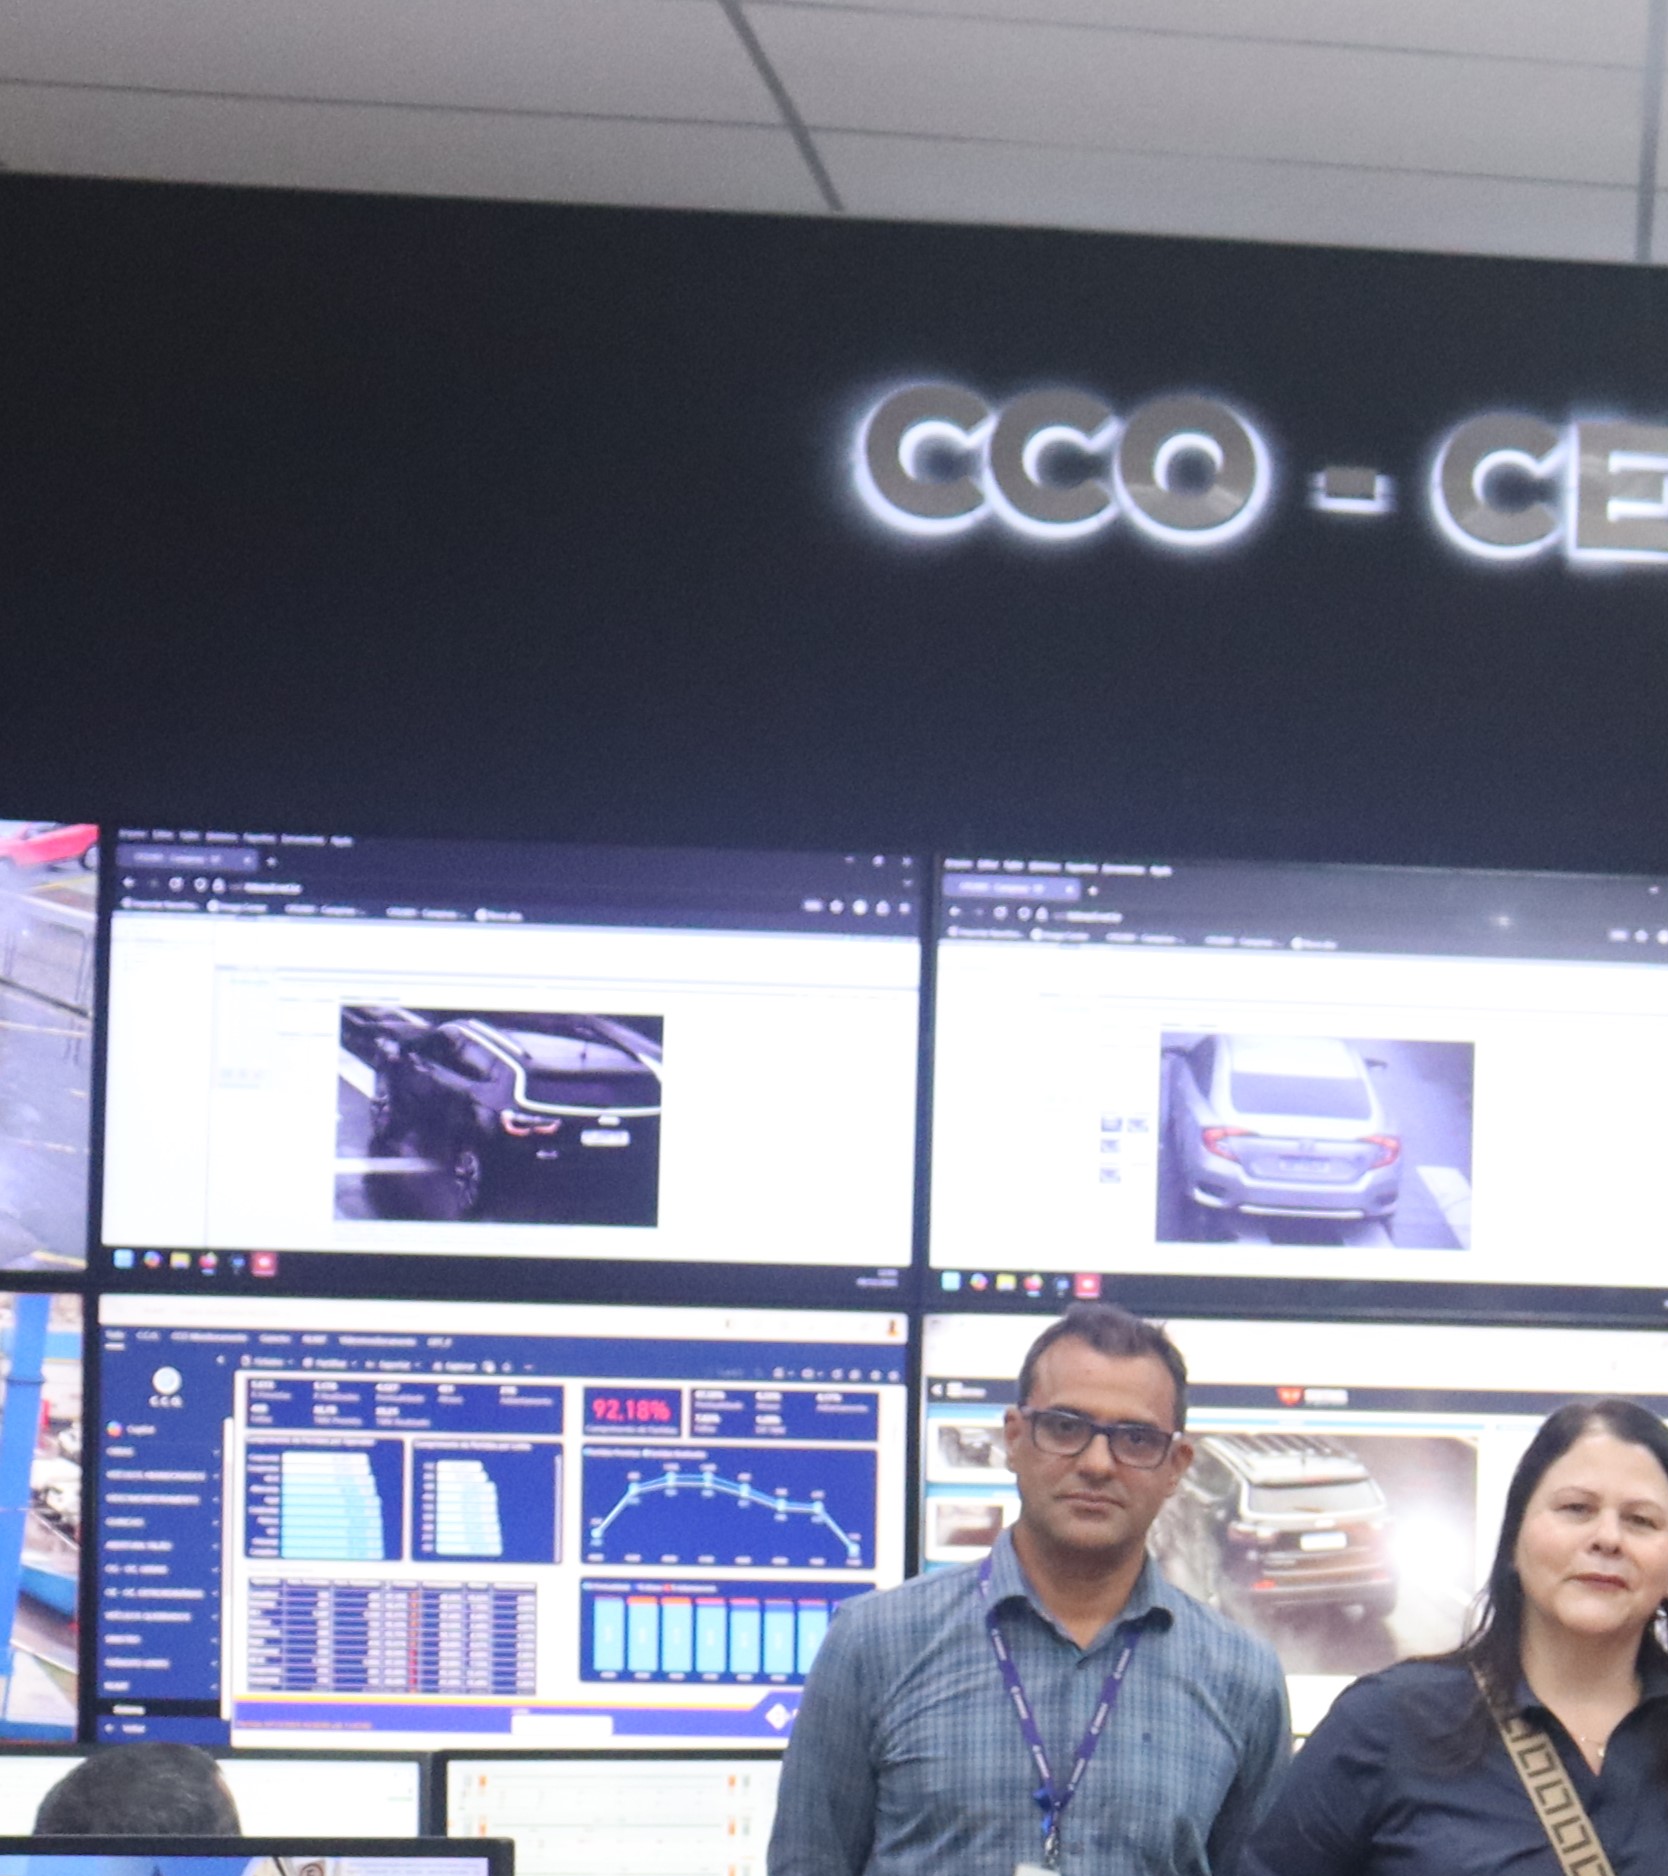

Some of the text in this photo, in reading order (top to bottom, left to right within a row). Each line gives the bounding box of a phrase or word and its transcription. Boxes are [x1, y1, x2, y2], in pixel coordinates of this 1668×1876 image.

[858, 382, 1266, 544] CCO
[1314, 463, 1391, 513] -
[592, 1398, 672, 1422] 92.18%
